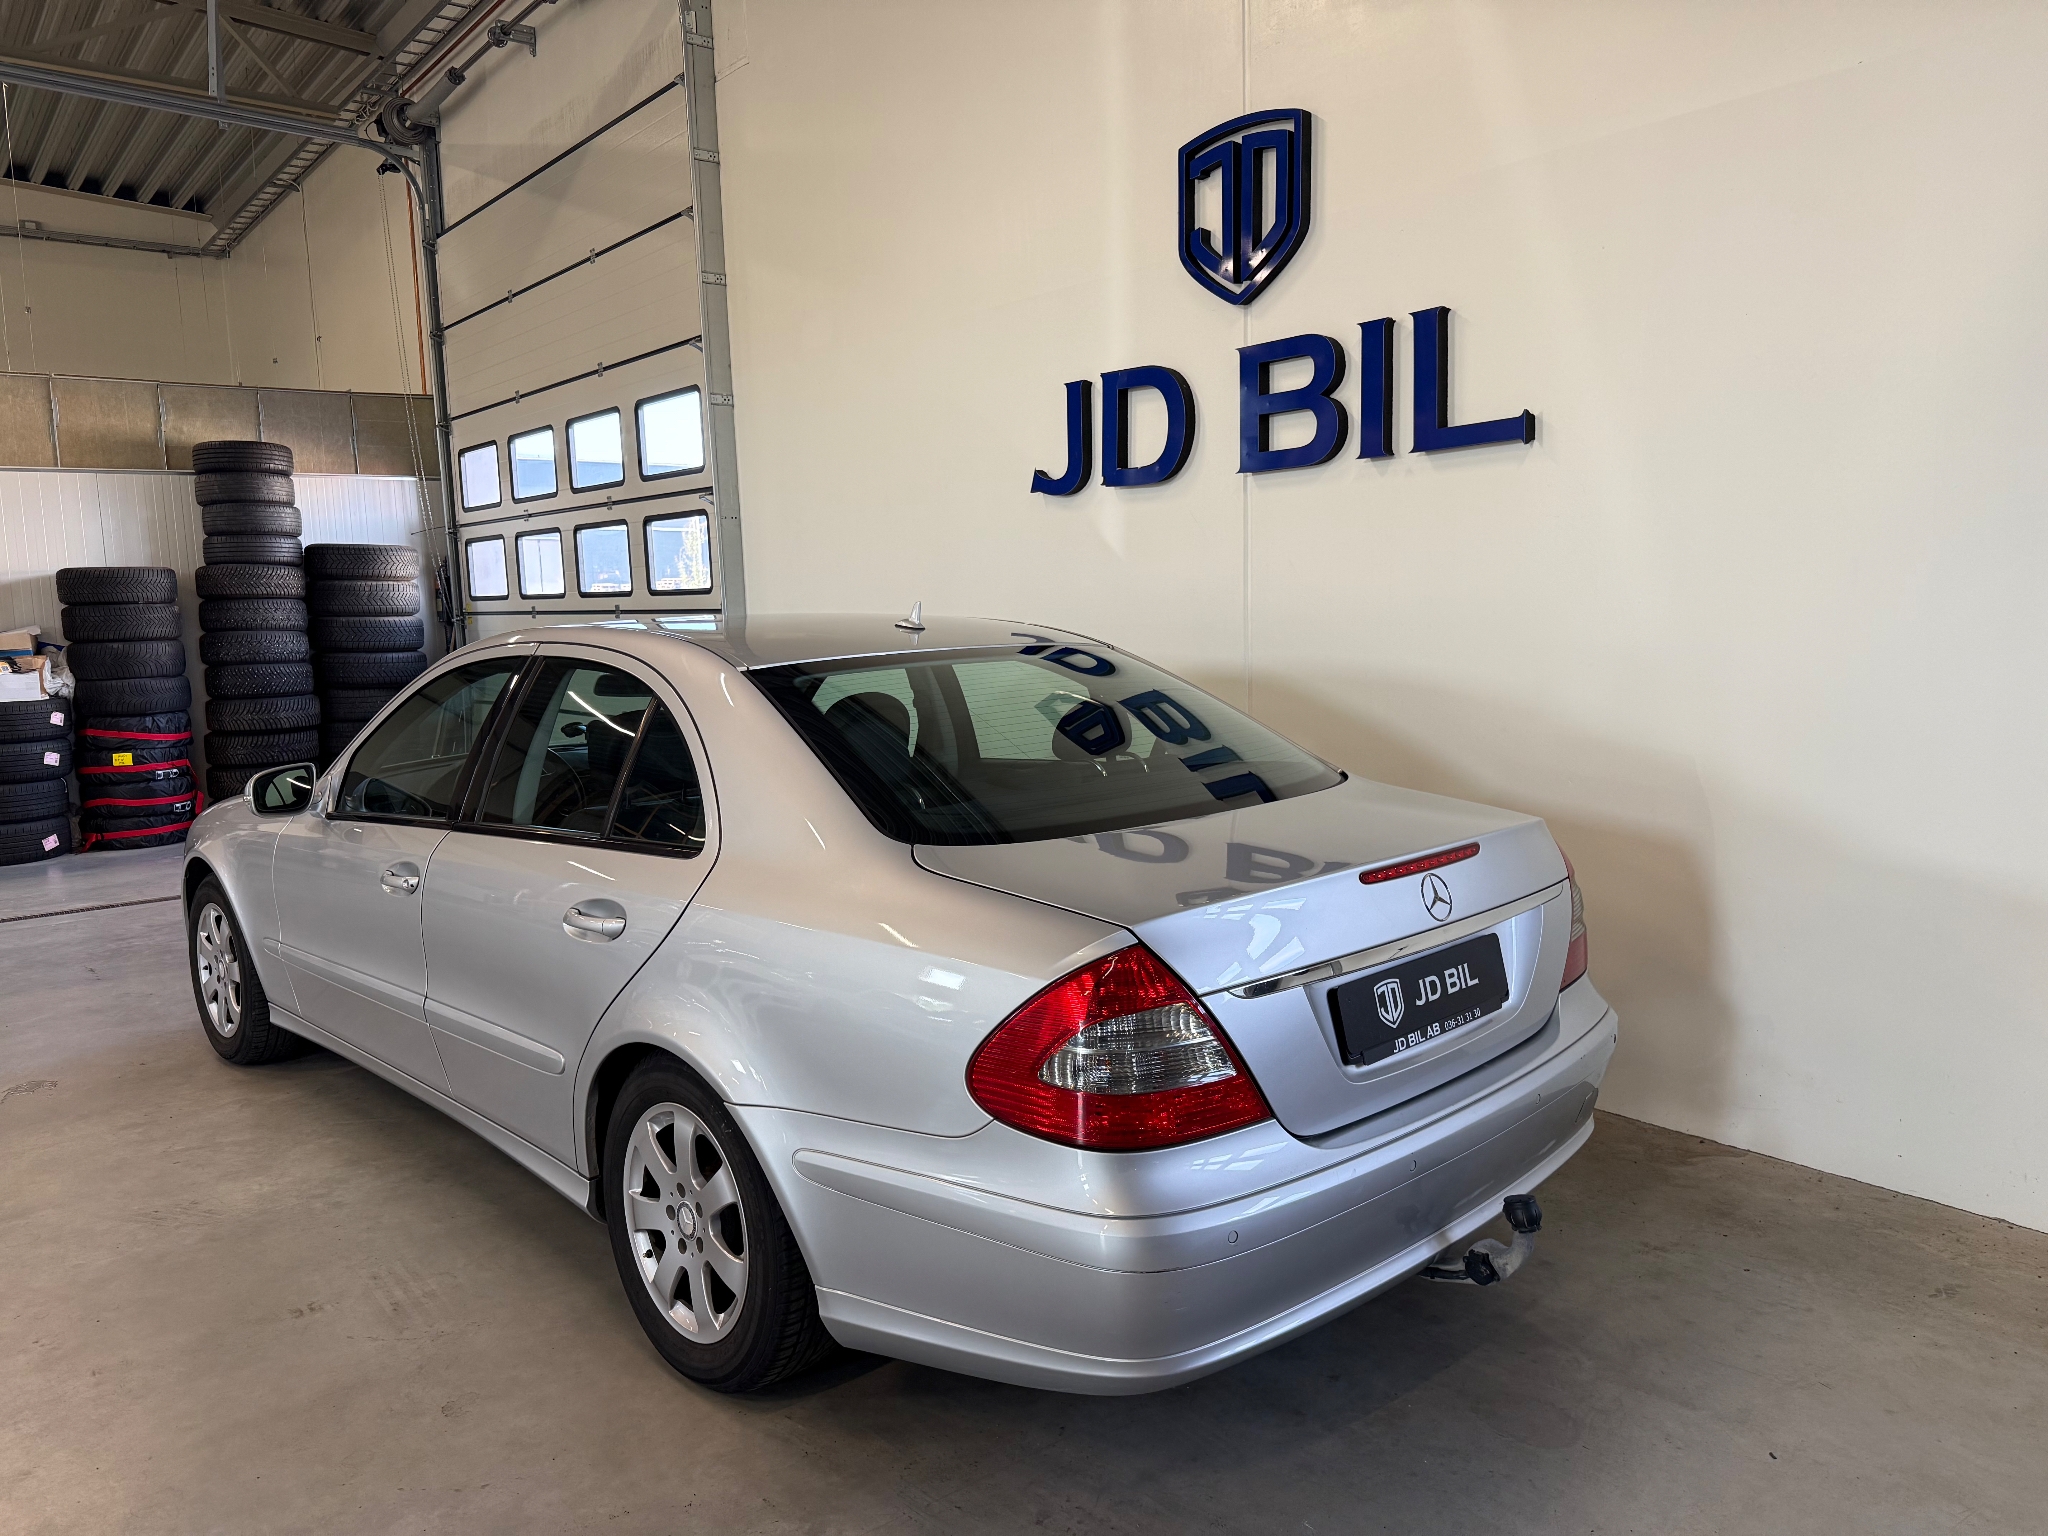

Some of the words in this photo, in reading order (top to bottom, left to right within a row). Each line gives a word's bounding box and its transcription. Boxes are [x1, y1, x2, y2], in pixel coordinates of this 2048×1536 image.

[1030, 364, 1197, 496] JD
[1235, 306, 1536, 475] BIL
[1415, 975, 1442, 1006] JD
[1443, 962, 1479, 995] BIL
[1393, 1037, 1407, 1053] JD
[1407, 1030, 1426, 1047] BIL
[1427, 1022, 1441, 1039] AB
[1444, 1015, 1465, 1031] 036-31
[1465, 1011, 1473, 1022] 31
[1473, 1007, 1481, 1018] 30
